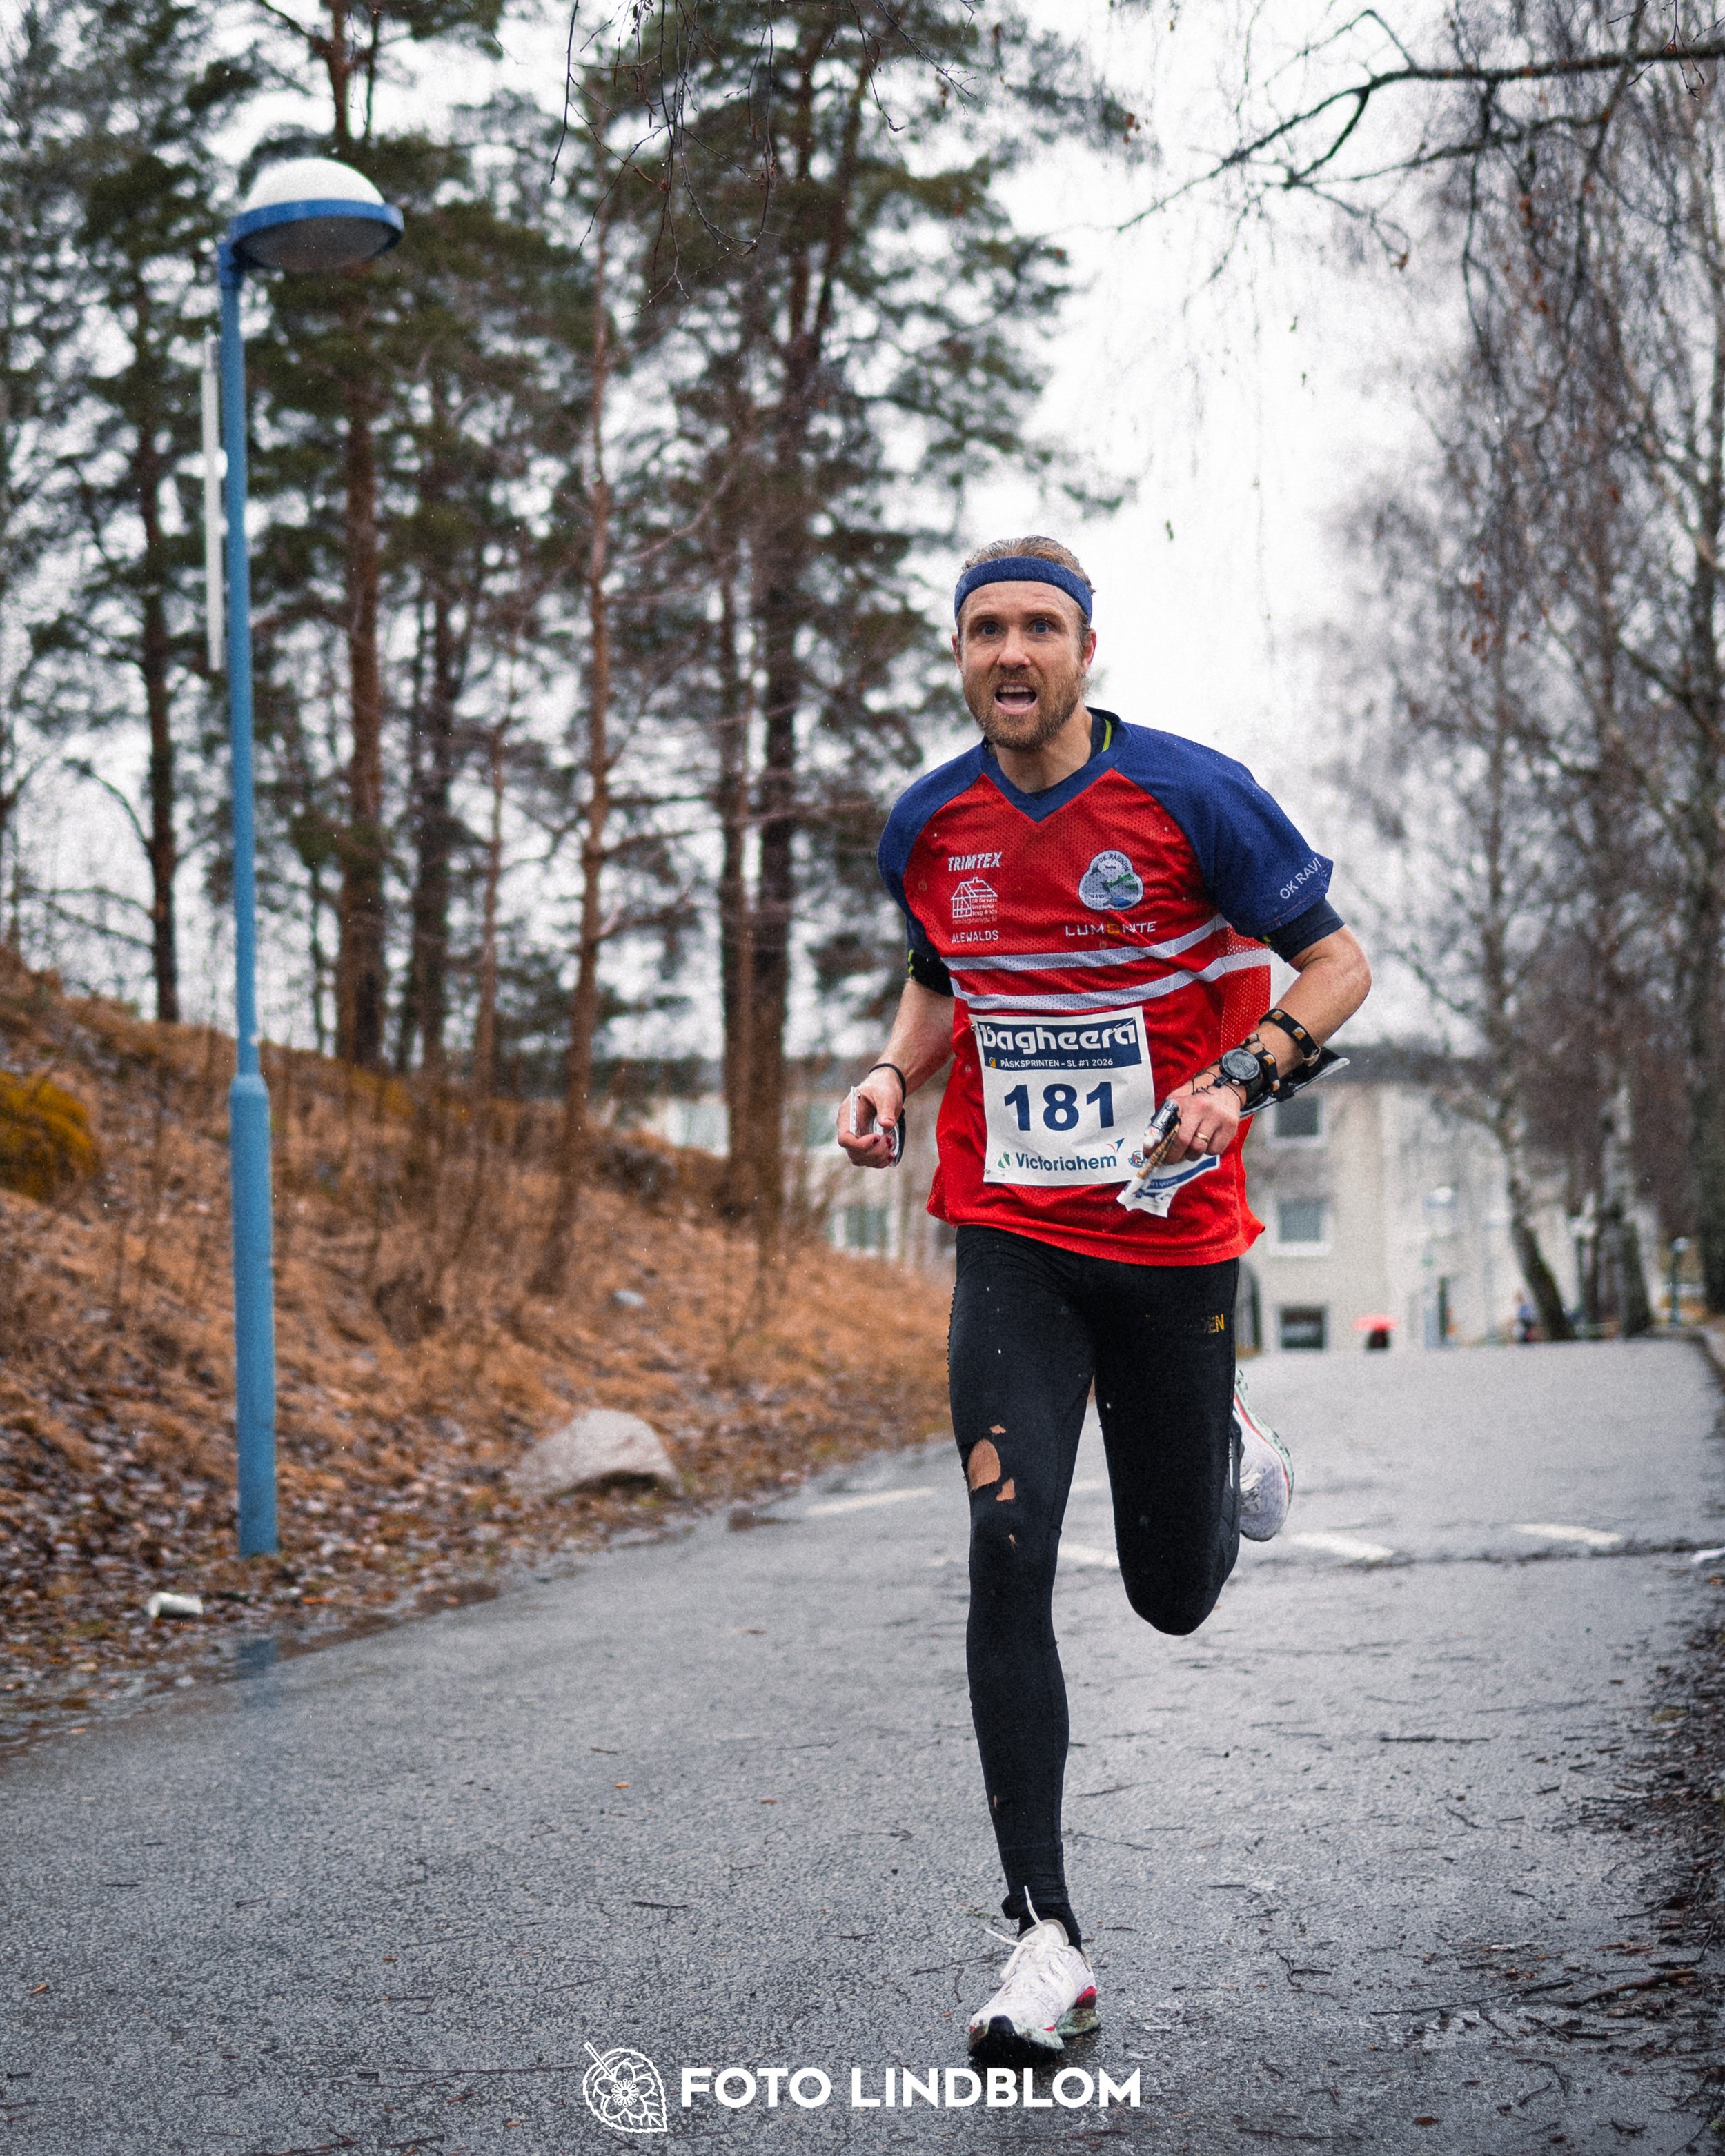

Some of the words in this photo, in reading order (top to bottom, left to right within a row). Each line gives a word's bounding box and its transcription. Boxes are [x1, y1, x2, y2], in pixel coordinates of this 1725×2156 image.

[948, 851, 1003, 871] TRIMTEX
[1279, 880, 1299, 899] OK
[952, 930, 999, 944] ALEWALDS
[981, 1024, 1137, 1054] bagheera
[1000, 1058, 1060, 1068] PÅSKSPRINTEN
[1092, 1058, 1114, 1067] 2026
[1004, 1081, 1114, 1131] 181
[1015, 1152, 1117, 1171] Victoriahem
